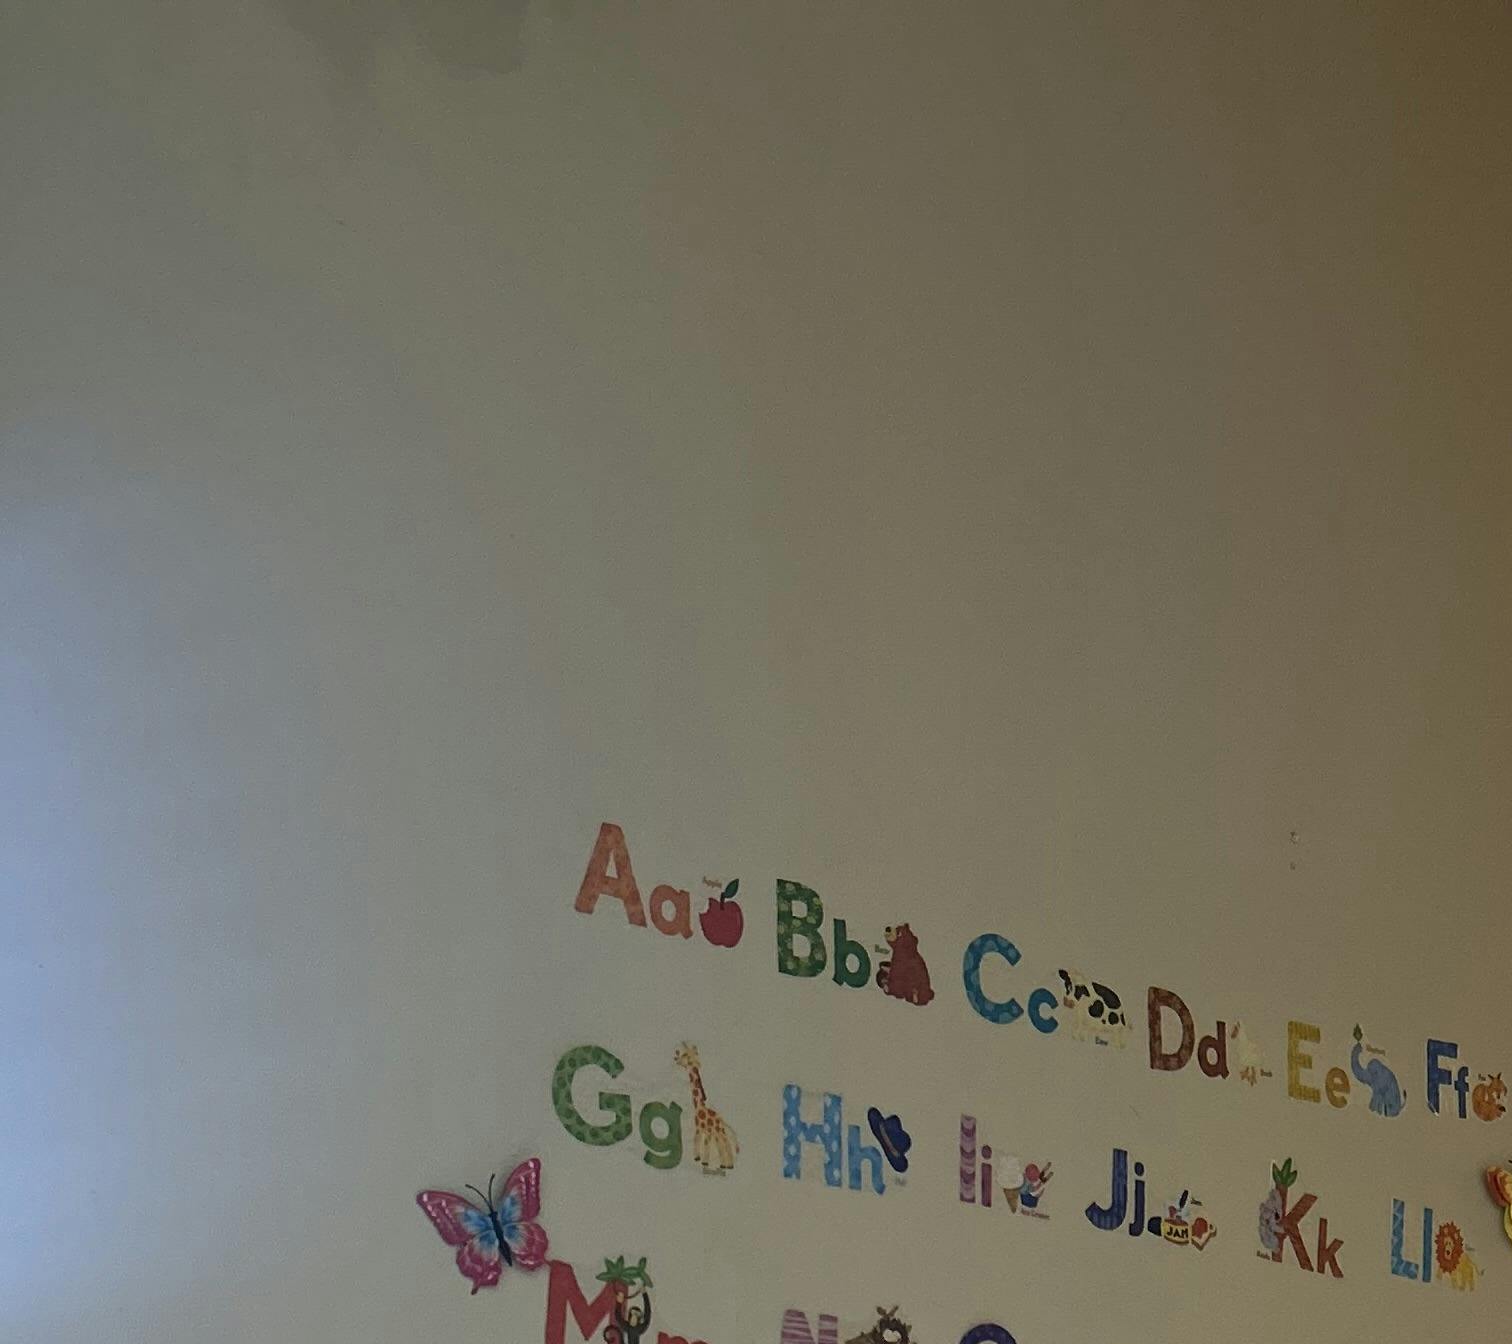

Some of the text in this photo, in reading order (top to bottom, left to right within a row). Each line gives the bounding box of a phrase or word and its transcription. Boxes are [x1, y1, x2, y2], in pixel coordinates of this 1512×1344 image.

[574, 823, 1469, 1119] Aa Bb Cc Dd Ee Ff
[552, 1045, 1432, 1283] Gg Hh Ii Jj Kk Ll
[1164, 1226, 1189, 1240] JAM
